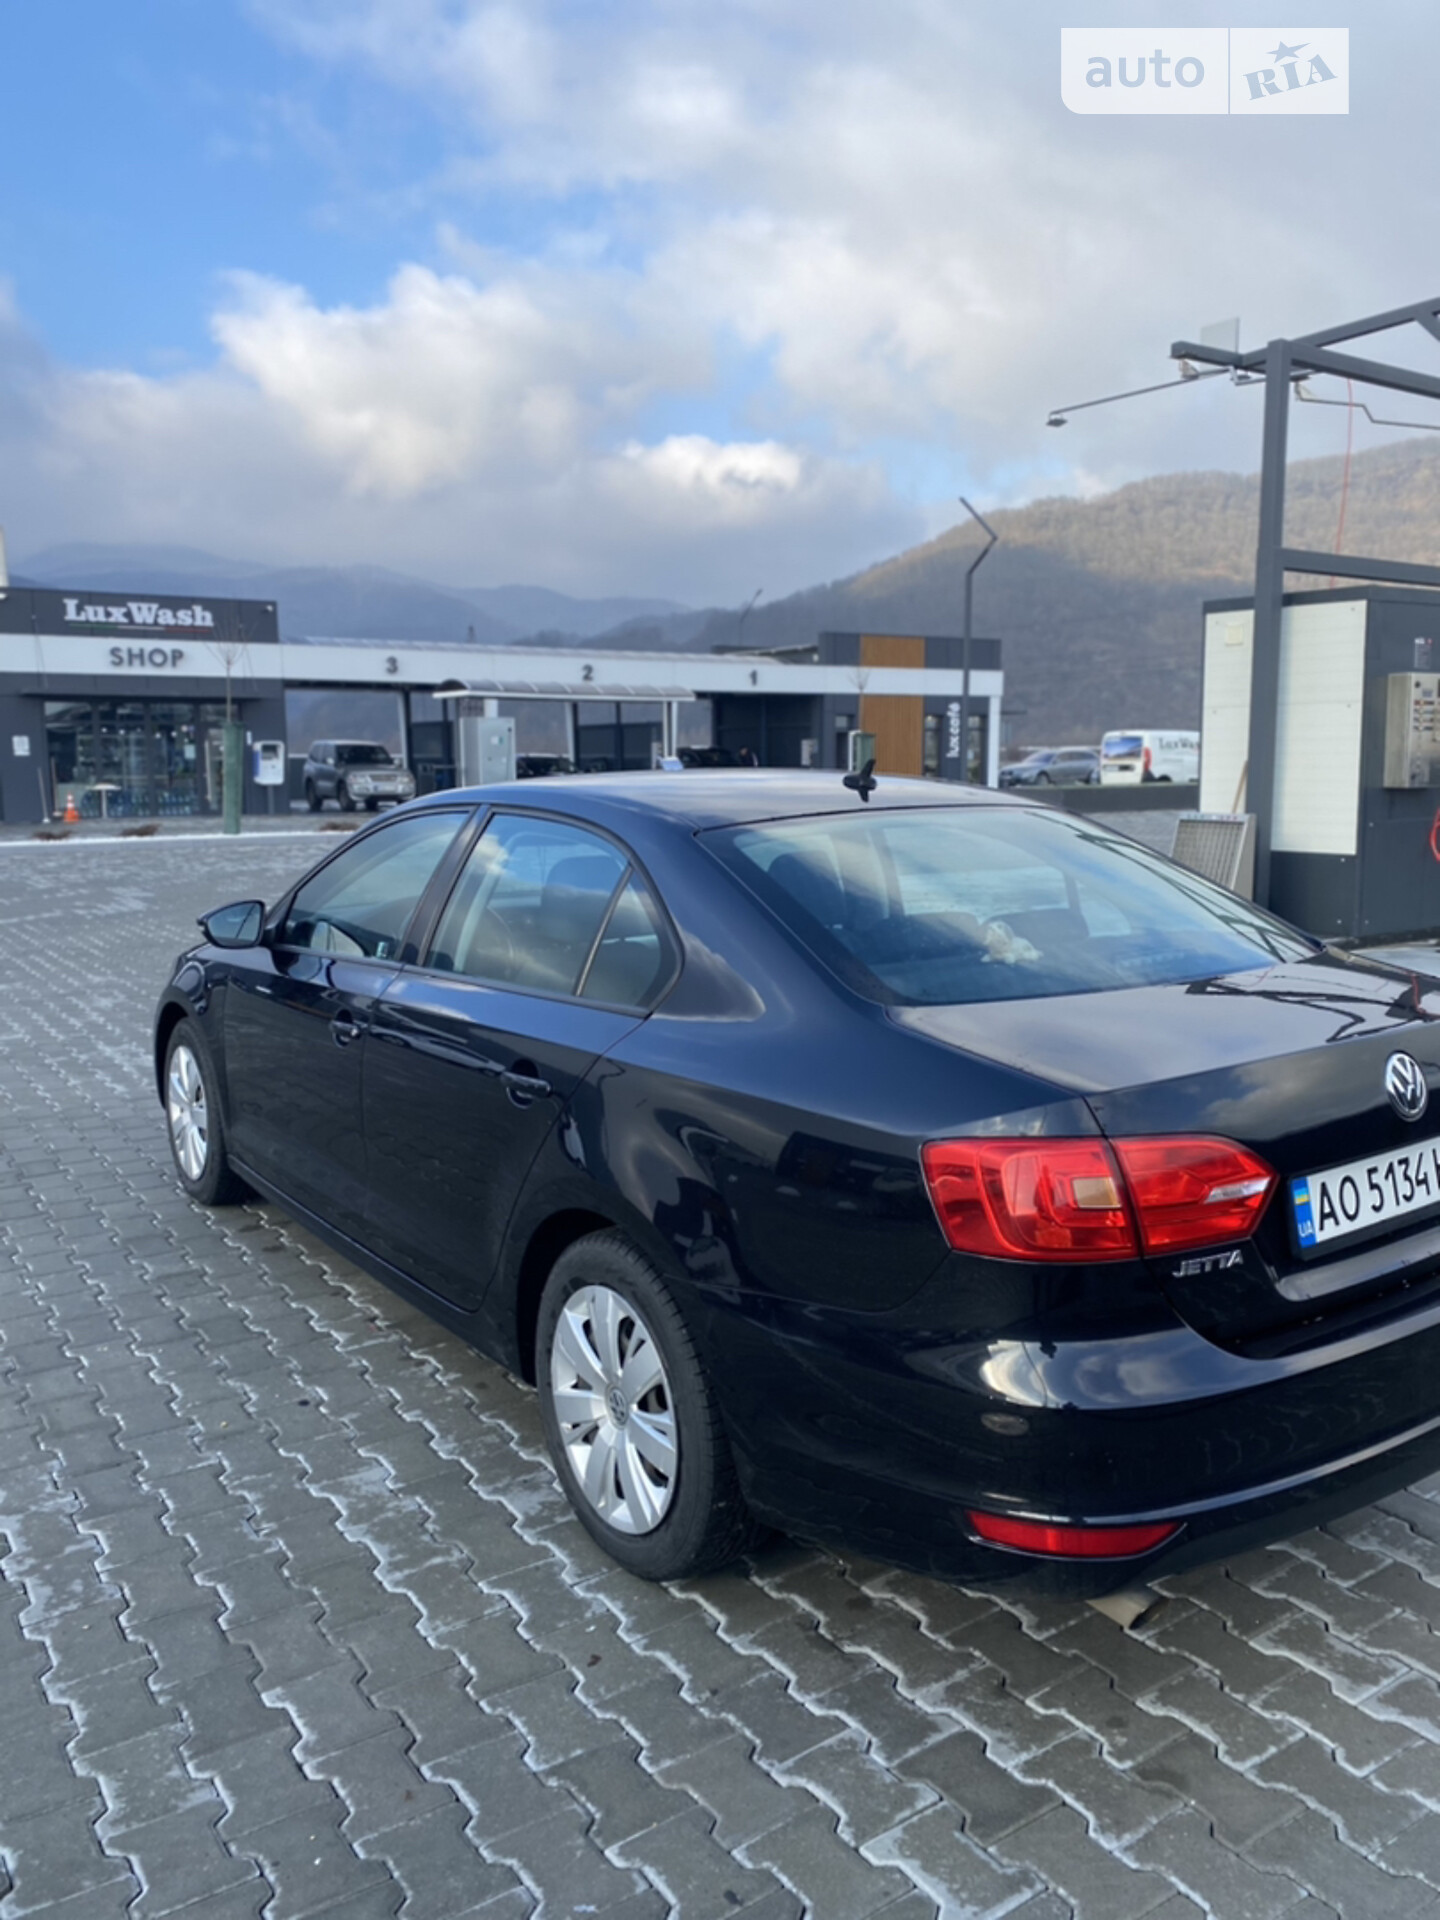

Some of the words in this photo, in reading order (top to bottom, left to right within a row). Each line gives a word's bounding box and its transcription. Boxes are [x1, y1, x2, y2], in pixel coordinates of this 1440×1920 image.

[63, 598, 214, 627] LuxWash
[109, 646, 184, 668] SHOP
[386, 656, 399, 674] 3
[582, 664, 594, 682] 2
[749, 669, 759, 686] 1
[1366, 1151, 1431, 1213] 5134
[1297, 1219, 1314, 1238] UA
[1172, 1249, 1243, 1278] JETTA
